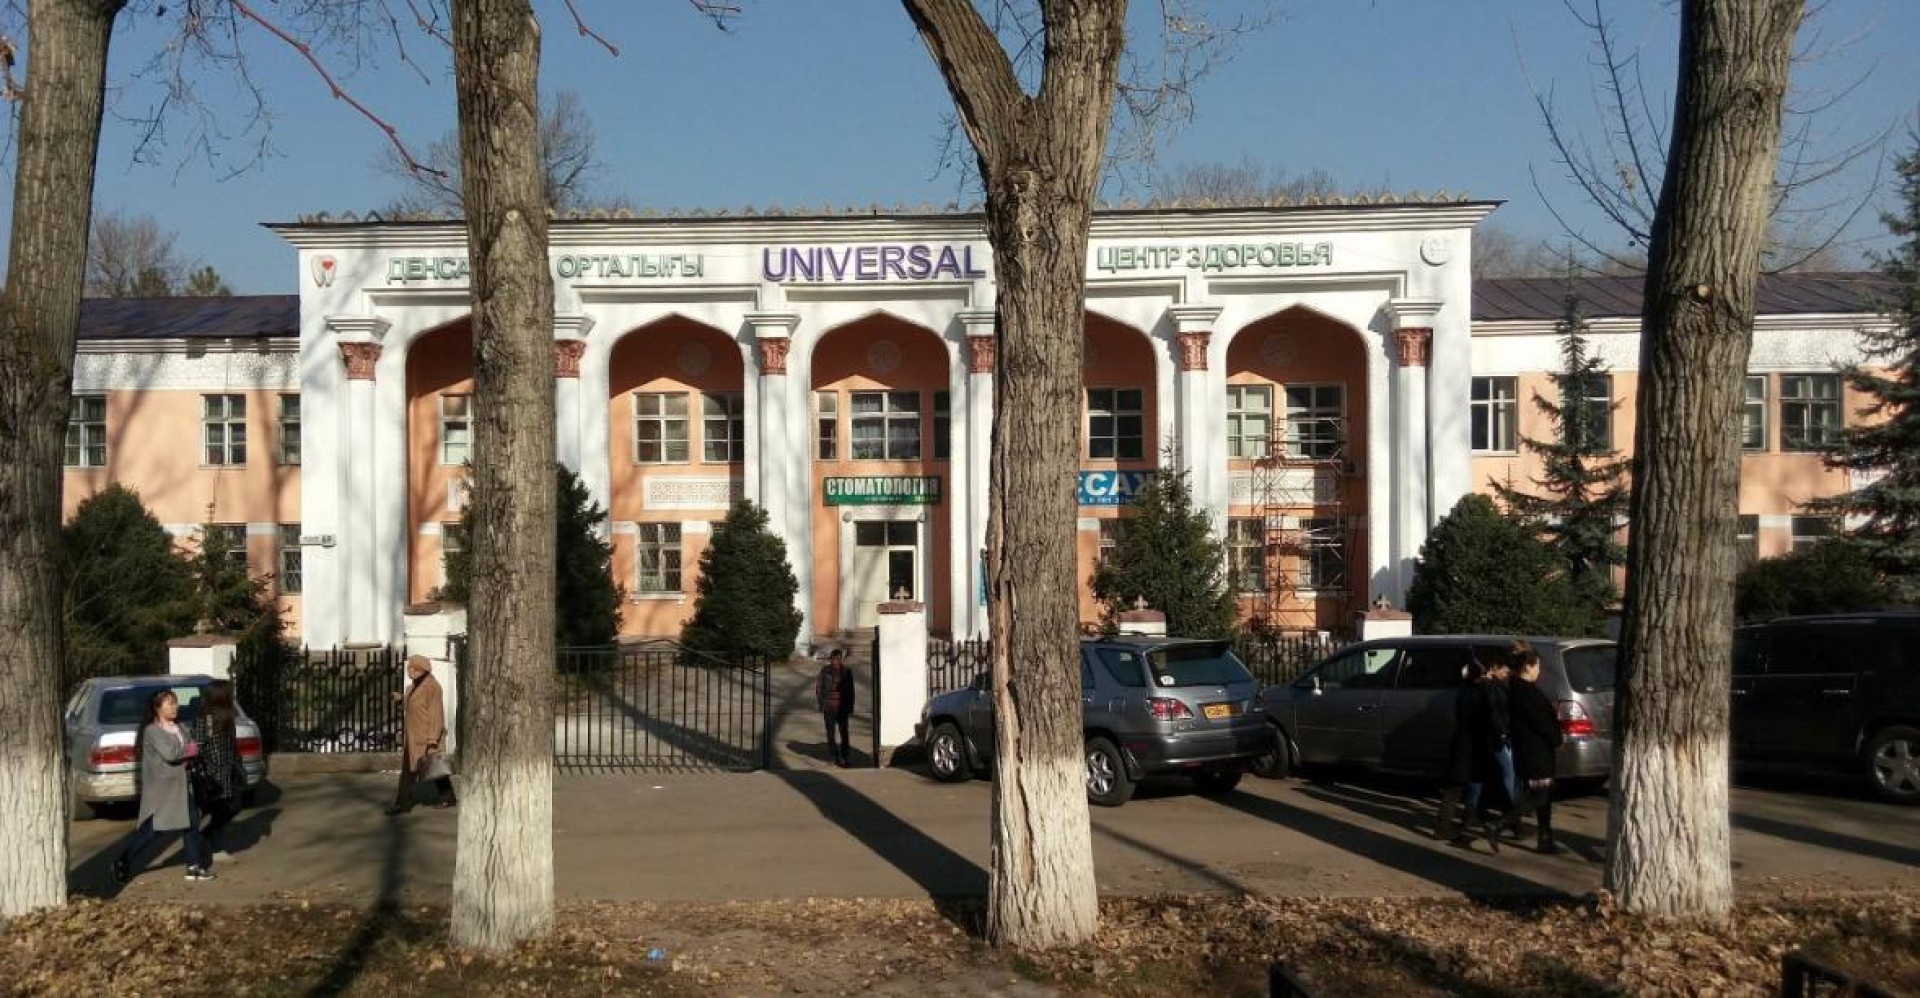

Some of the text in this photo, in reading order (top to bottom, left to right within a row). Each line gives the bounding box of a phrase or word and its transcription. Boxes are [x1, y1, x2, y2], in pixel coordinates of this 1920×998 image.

[386, 253, 705, 285] ДЕНСА ОРТАЛЫҒЫ
[762, 244, 987, 282] UNIVERSAL
[1097, 241, 1334, 273] ЦЕНТР ЗДОРОВЬЯ
[826, 477, 940, 496] СТОМАТОЛОГИЯ
